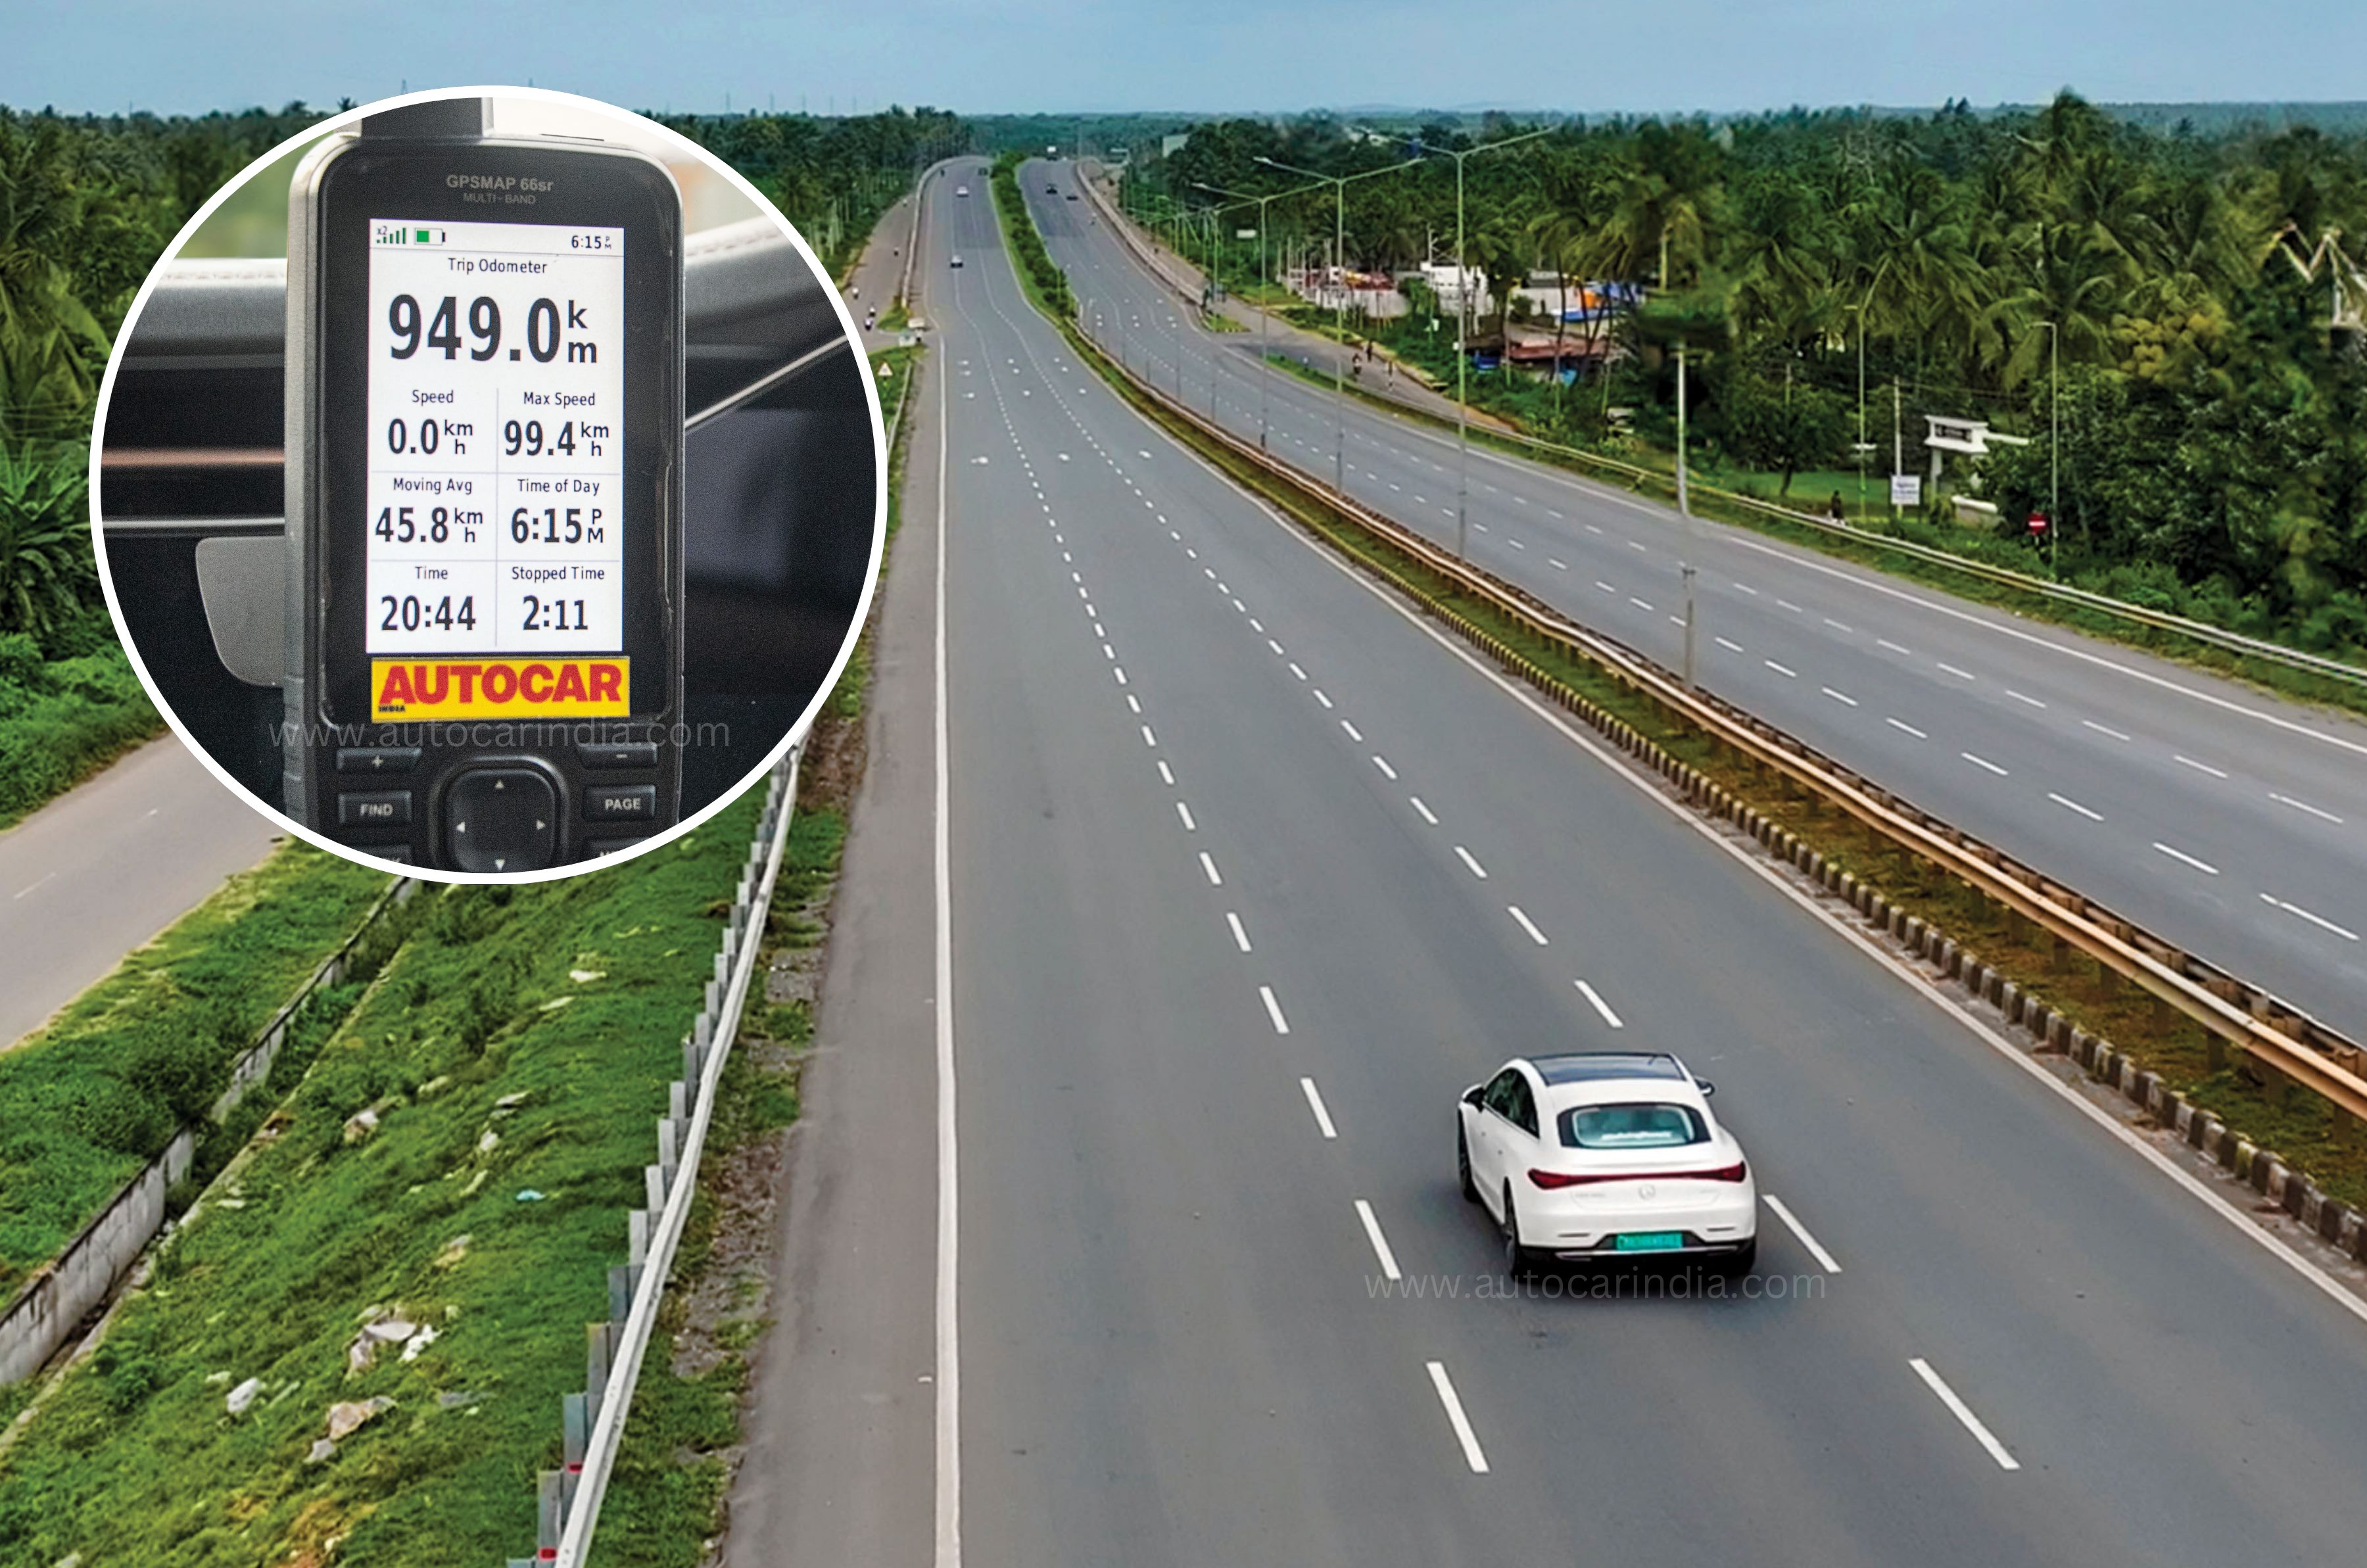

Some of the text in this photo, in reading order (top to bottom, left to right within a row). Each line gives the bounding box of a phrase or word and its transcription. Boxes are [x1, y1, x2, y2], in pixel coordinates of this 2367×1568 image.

[446, 175, 554, 191] GPSMAP 66sr
[571, 235, 602, 249] 6:15
[448, 258, 547, 273] Trip Odometer
[388, 293, 561, 364] 949.0
[412, 390, 454, 406] Speed
[523, 391, 596, 408] Max Speed
[388, 417, 473, 455] 0.0 km
[504, 419, 609, 457] 99.4 km
[393, 477, 473, 496] Moving Avg
[517, 479, 600, 496] Time of Day
[375, 506, 483, 544] 45.8 km
[510, 508, 582, 544] 6:15
[415, 566, 448, 581] Time
[512, 566, 605, 583] Stopped Time
[380, 594, 476, 632] 20:44
[523, 594, 588, 630] 2:11
[379, 663, 622, 704] AUTOCAR
[360, 802, 393, 817] FIND
[605, 797, 641, 811] PAGE
